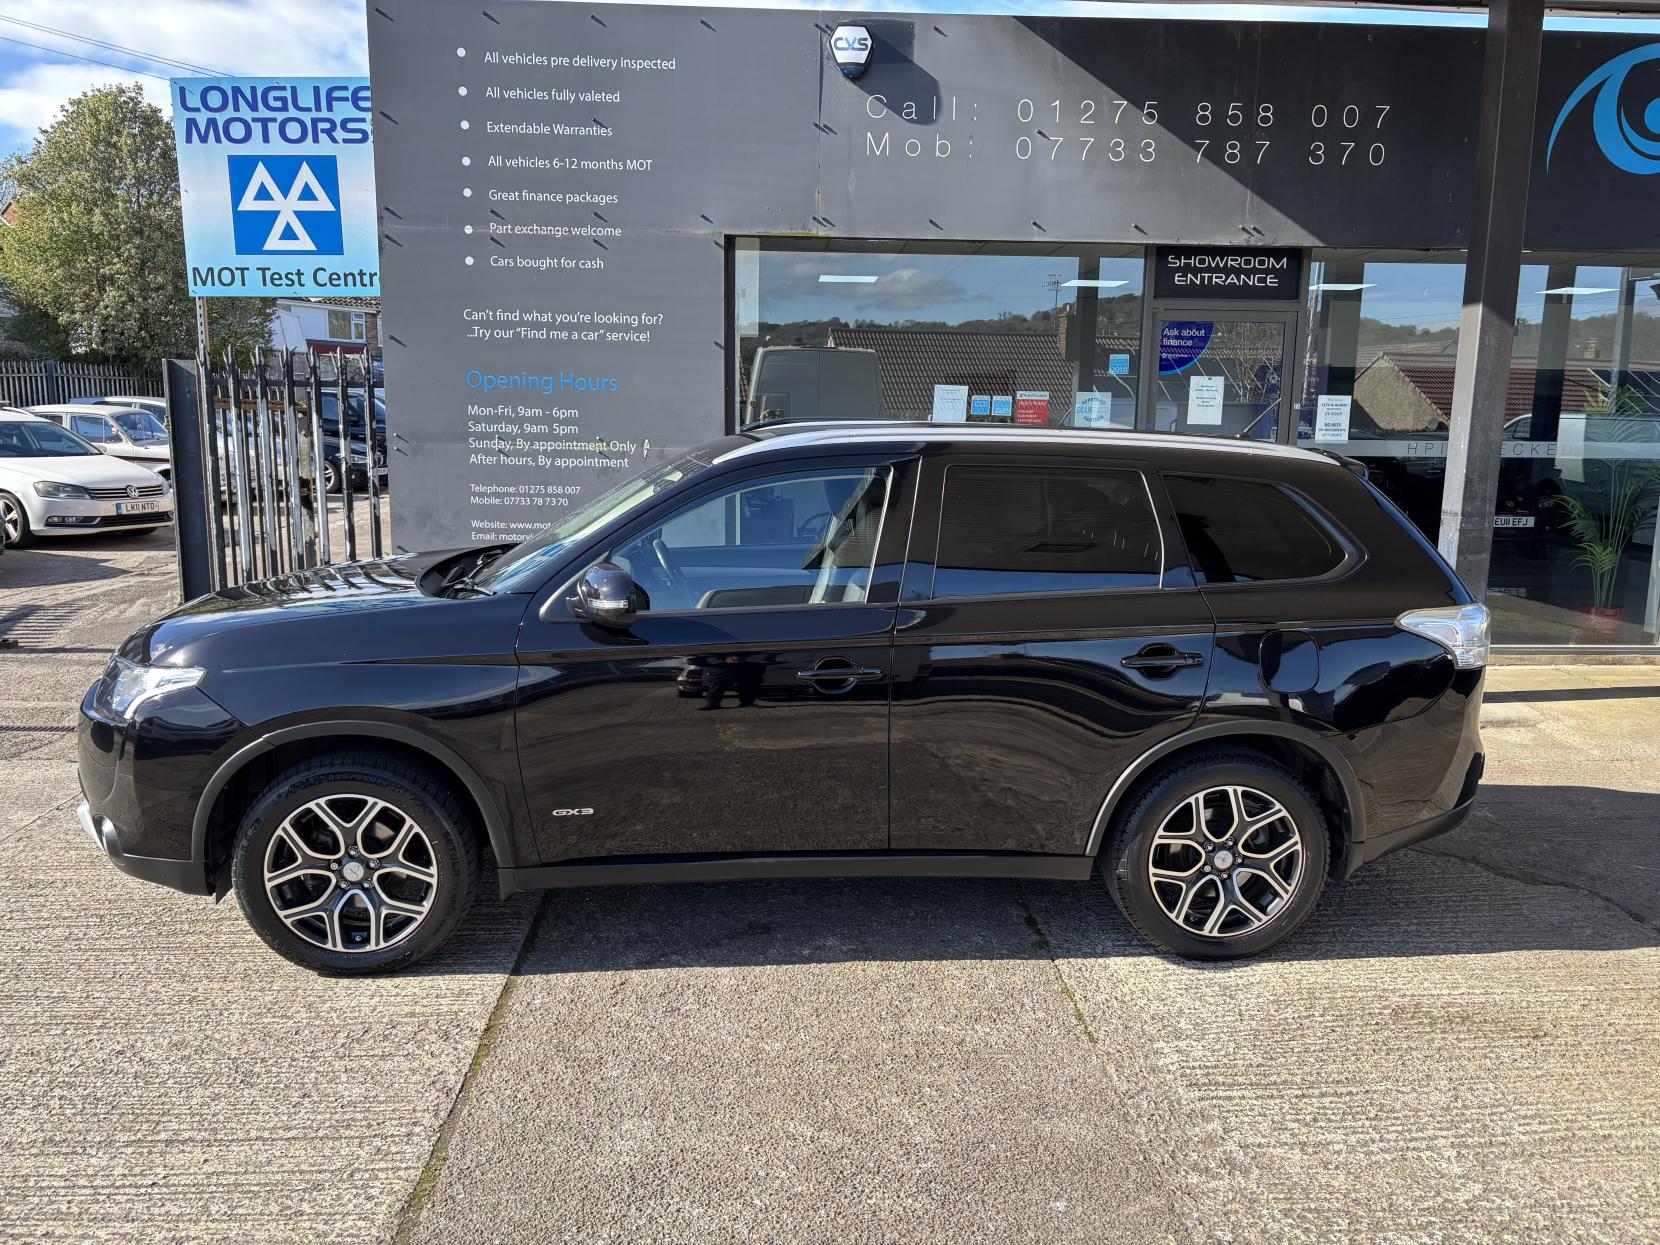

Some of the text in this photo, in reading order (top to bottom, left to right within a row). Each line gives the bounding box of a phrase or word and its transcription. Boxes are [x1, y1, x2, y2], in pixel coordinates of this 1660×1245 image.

[484, 51, 676, 71] All vehicles pre delivery inspected
[179, 85, 371, 113] LONGLIFE
[486, 87, 620, 103] All vehicles fully valeted
[866, 94, 1390, 128] Call: 01275 858 007
[185, 116, 369, 144] MOTORS
[487, 122, 613, 136] Extendable Warranties
[866, 132, 1385, 166] Mob: 07733 787 370
[488, 156, 652, 171] All vehicles 6-12 months MOT
[488, 189, 618, 205] Great finance packages
[490, 223, 621, 238] Part exchange welcome
[490, 256, 604, 270] Cars bought for cash
[1168, 255, 1287, 269] SHOWROOM
[192, 267, 380, 287] MOT Test Centr
[1175, 273, 1279, 286] ENTRANCE
[496, 310, 519, 322] find
[522, 311, 552, 323] what
[594, 312, 638, 326] looking
[641, 313, 663, 325] for?
[494, 329, 514, 338] our
[550, 330, 568, 340] me
[572, 330, 578, 340] a
[606, 331, 650, 342] service!
[1163, 328, 1205, 336] Ask about
[1163, 338, 1192, 346] finance
[467, 370, 618, 394] Opening Hours
[468, 405, 515, 417] Mon-Fri,
[518, 406, 542, 417] 9am
[553, 407, 578, 419] 6pm
[468, 422, 578, 435] Saturday, 9am 5pm
[469, 438, 636, 454] Sunday, By appointment Only
[1408, 443, 1443, 455] HPI
[470, 454, 629, 469] After hours, By appointment
[470, 484, 517, 494] Telephone:
[565, 486, 580, 494] 007
[470, 496, 502, 504] Mobile:
[471, 520, 507, 528] Website:
[1512, 518, 1528, 526] EFJ
[472, 532, 497, 540] Email:
[552, 808, 594, 816] GX3
